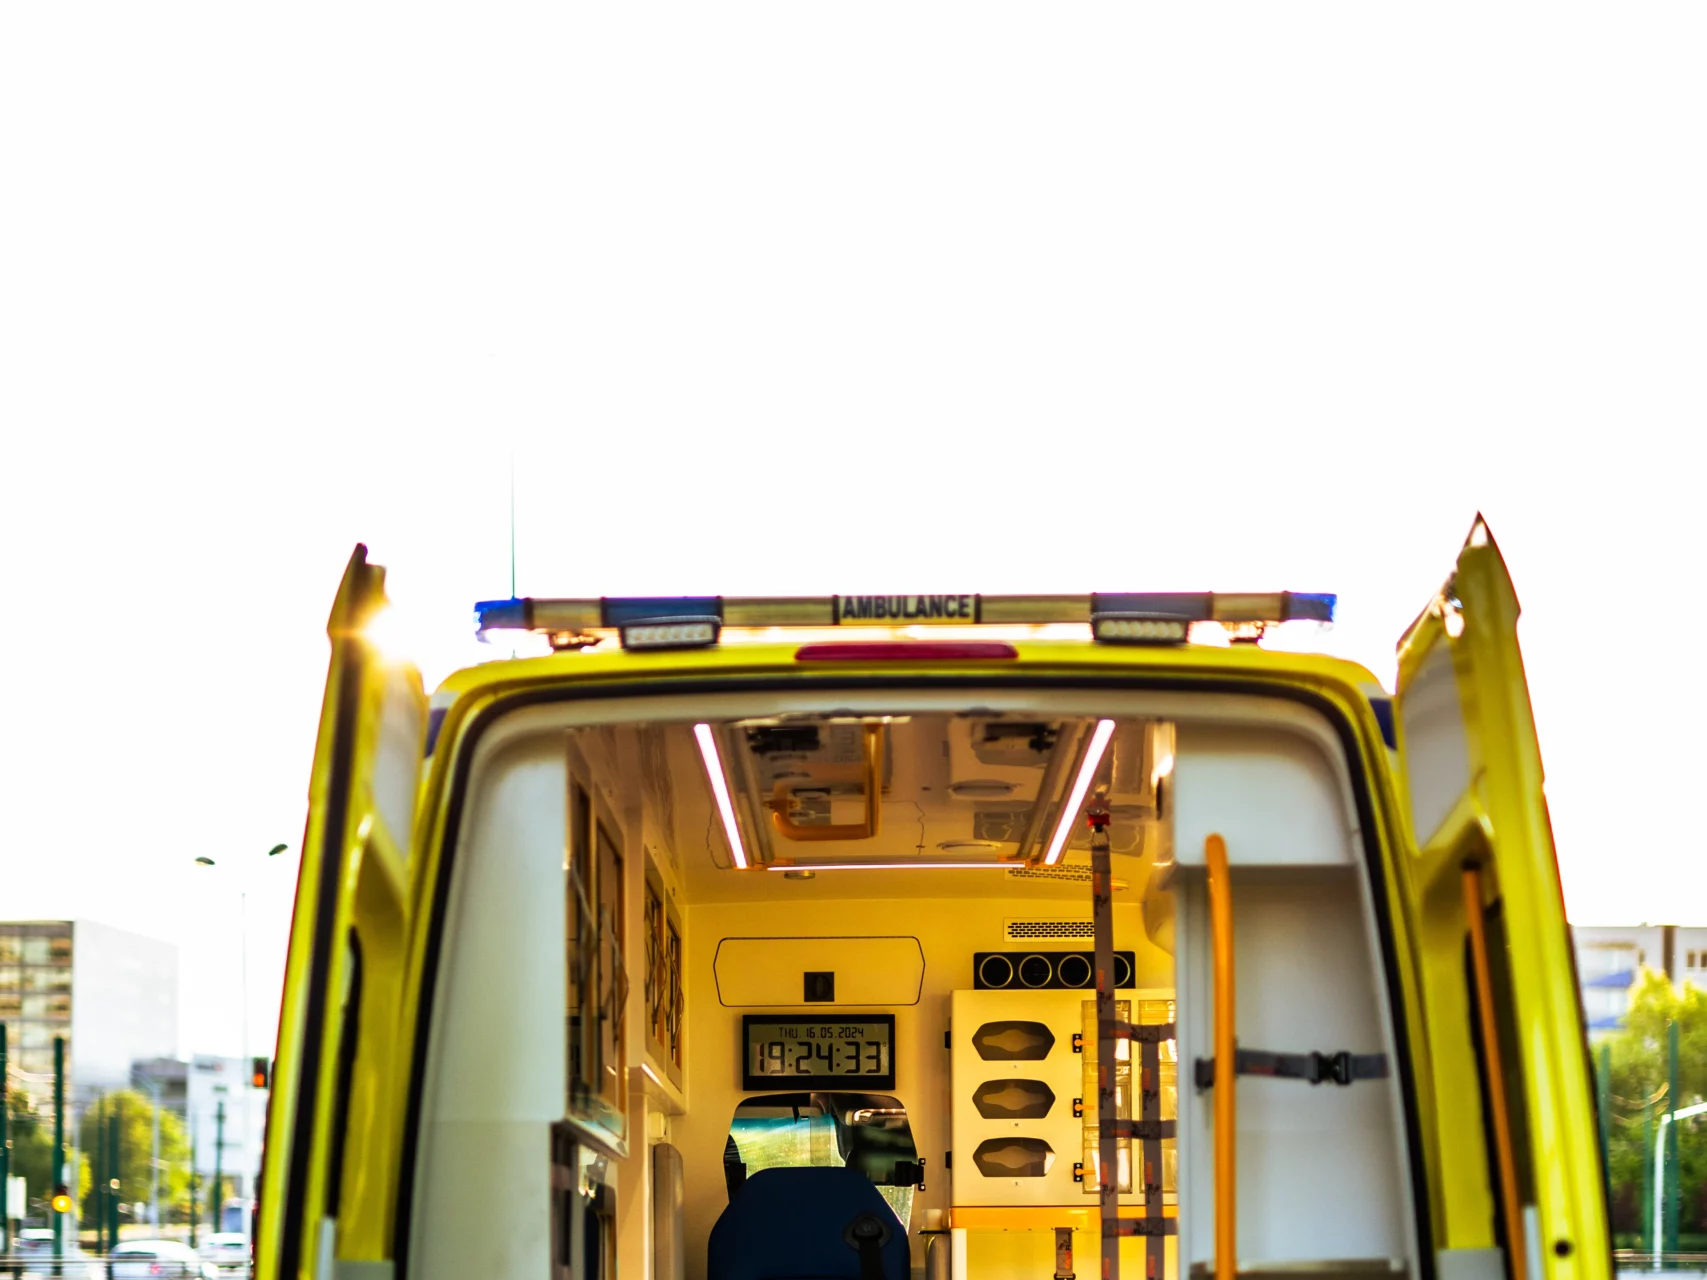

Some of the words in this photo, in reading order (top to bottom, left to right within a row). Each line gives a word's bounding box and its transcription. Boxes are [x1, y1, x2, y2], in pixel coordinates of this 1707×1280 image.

[843, 595, 970, 618] AMBULANCE
[806, 1026, 864, 1039] 16.05.2024
[759, 1041, 881, 1074] 19:24:33
